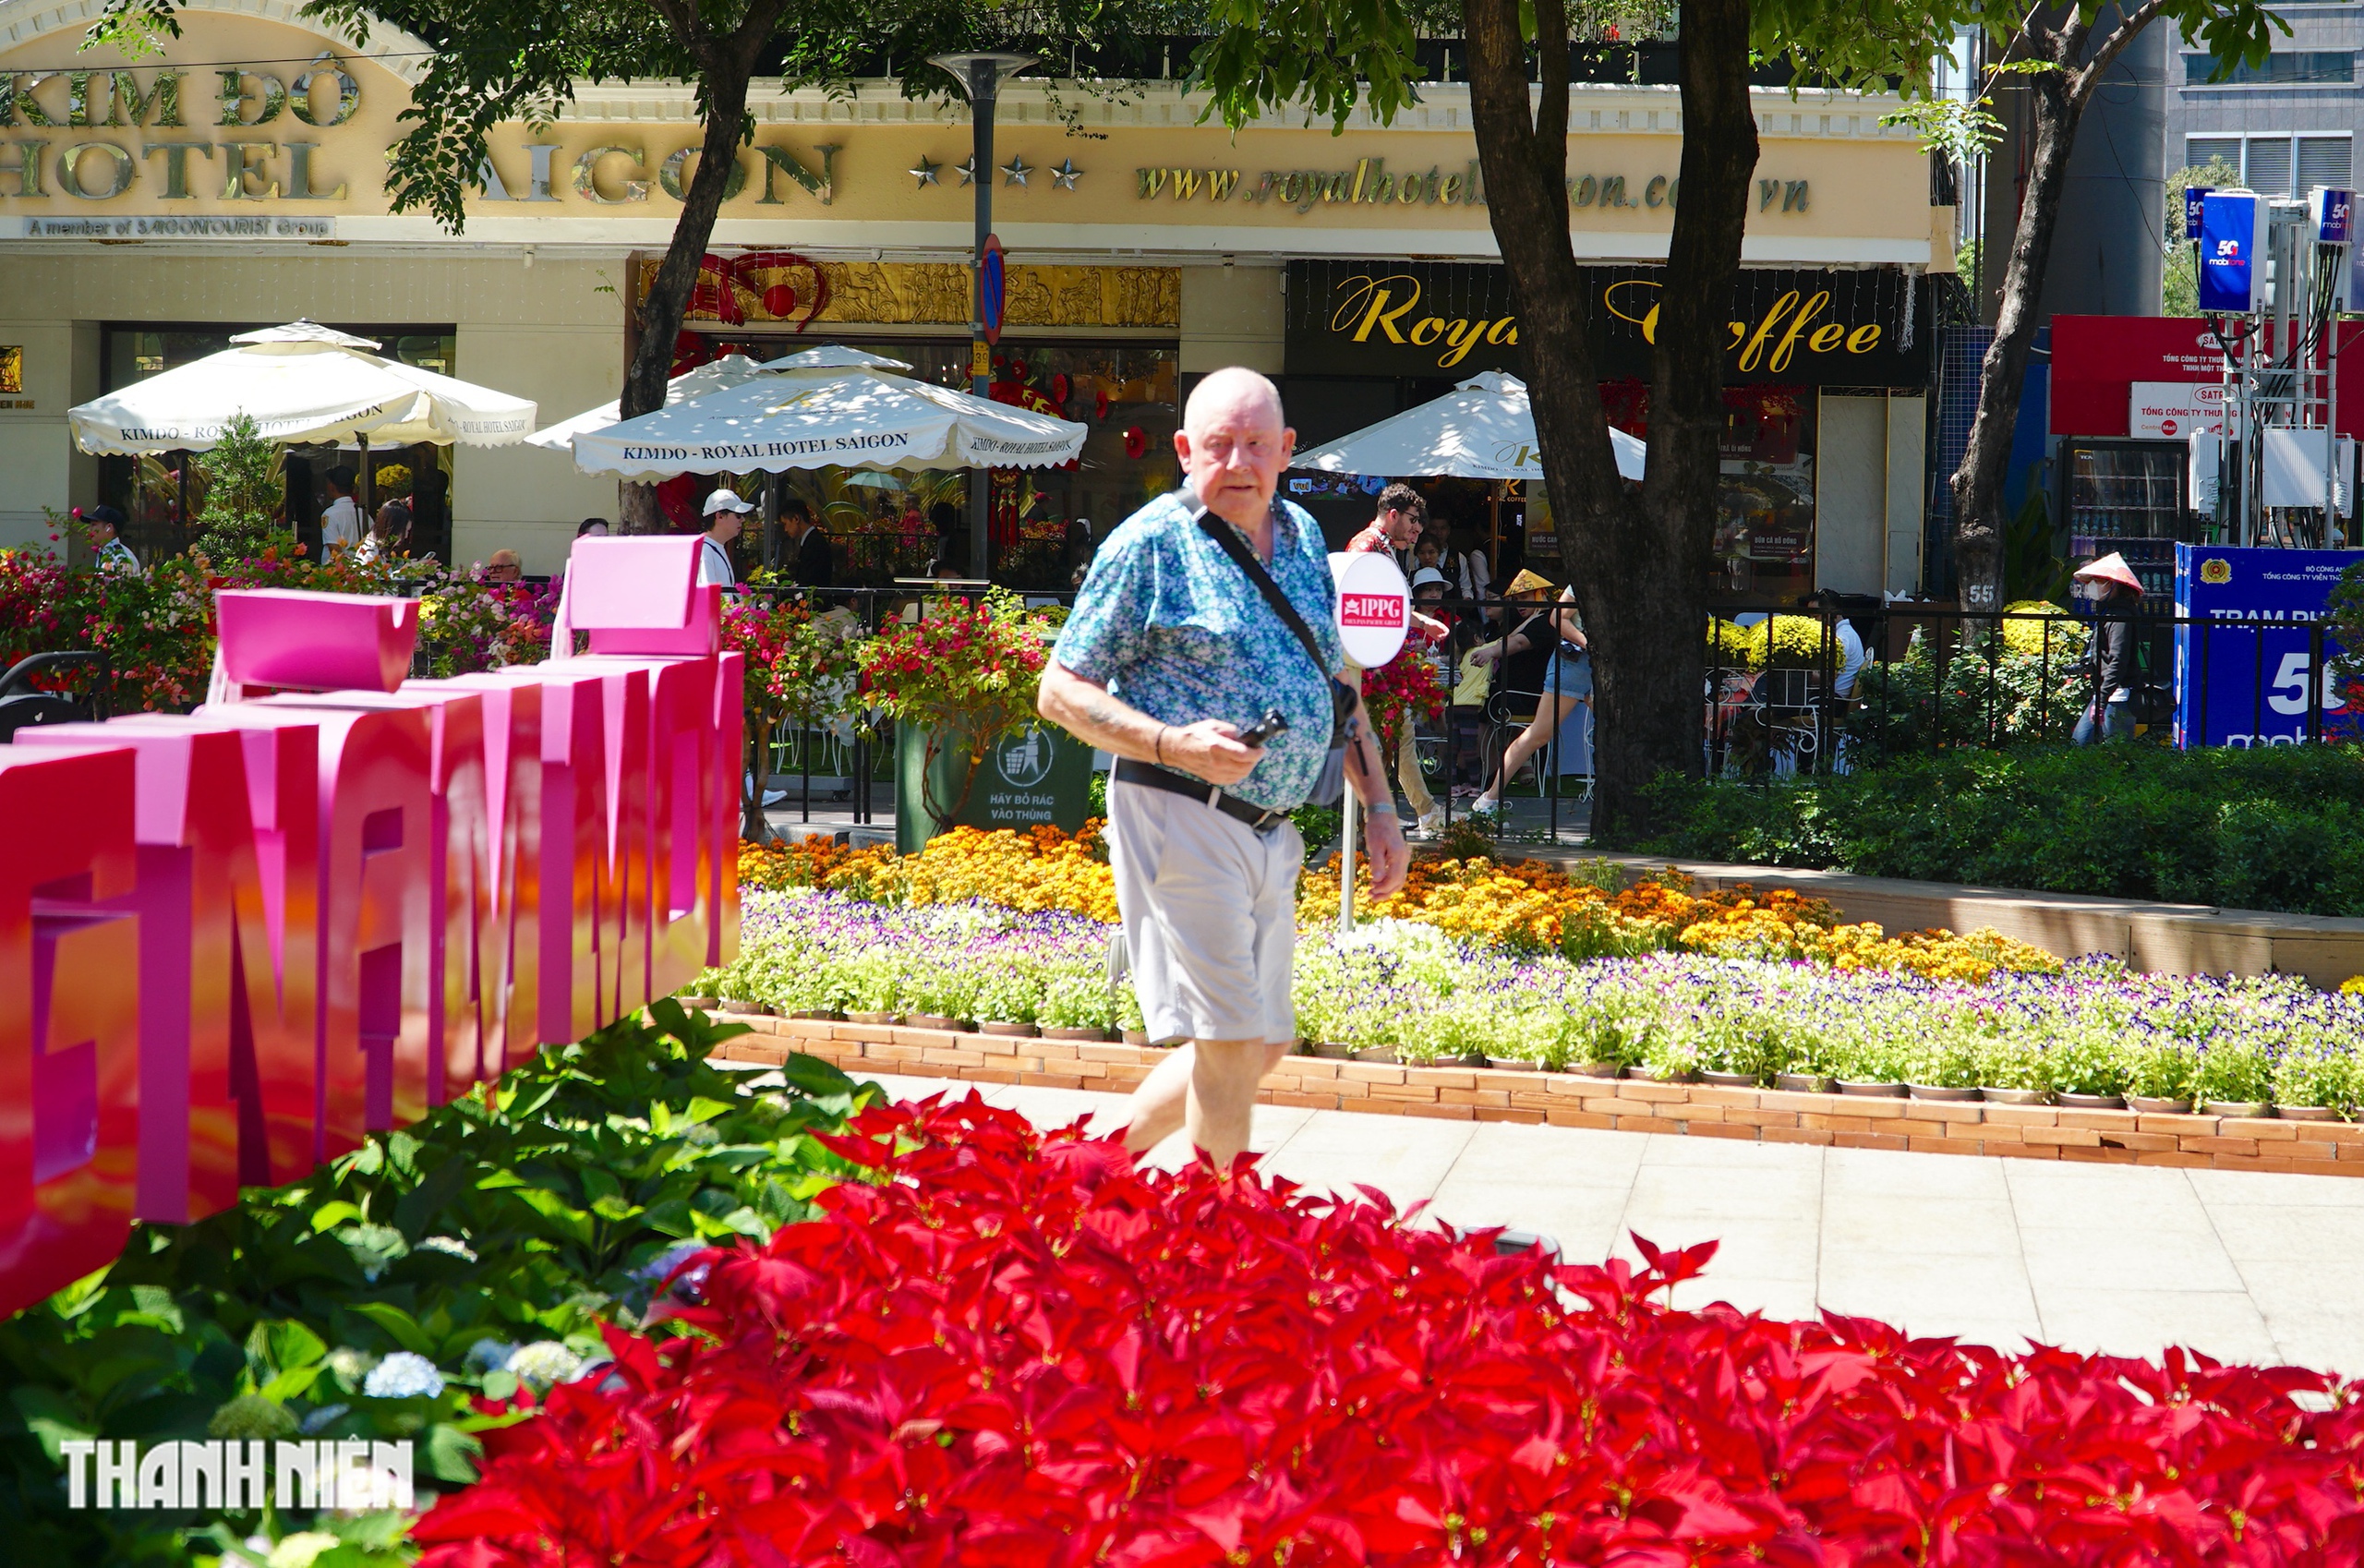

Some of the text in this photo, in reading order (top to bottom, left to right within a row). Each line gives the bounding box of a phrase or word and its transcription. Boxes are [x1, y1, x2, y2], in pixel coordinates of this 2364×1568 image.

[0, 50, 362, 127] KIM ĐÔ
[0, 140, 842, 205] HOTEL AIGON
[29, 222, 42, 235] A
[46, 221, 111, 235] member
[115, 221, 132, 235] of
[276, 222, 330, 238] Group
[2216, 240, 2239, 256] 5G
[2208, 258, 2246, 267] mobifone
[1331, 275, 1519, 368] Roya
[2165, 407, 2189, 416] CÔNG
[120, 428, 179, 441] KIMDO
[622, 446, 687, 461] KIMDO
[702, 442, 765, 460] ROYAL
[768, 439, 832, 456] HOTEL
[835, 432, 910, 451] SAIGON
[971, 437, 996, 452] KIMDO
[999, 441, 1027, 454] ROYAL
[1026, 441, 1048, 454] HOTEL
[1969, 585, 1994, 603] 55
[1361, 597, 1401, 619] IPPG
[990, 791, 1055, 805] HÃY BỎ RÁC
[991, 807, 1052, 821] VÀO THÙNG
